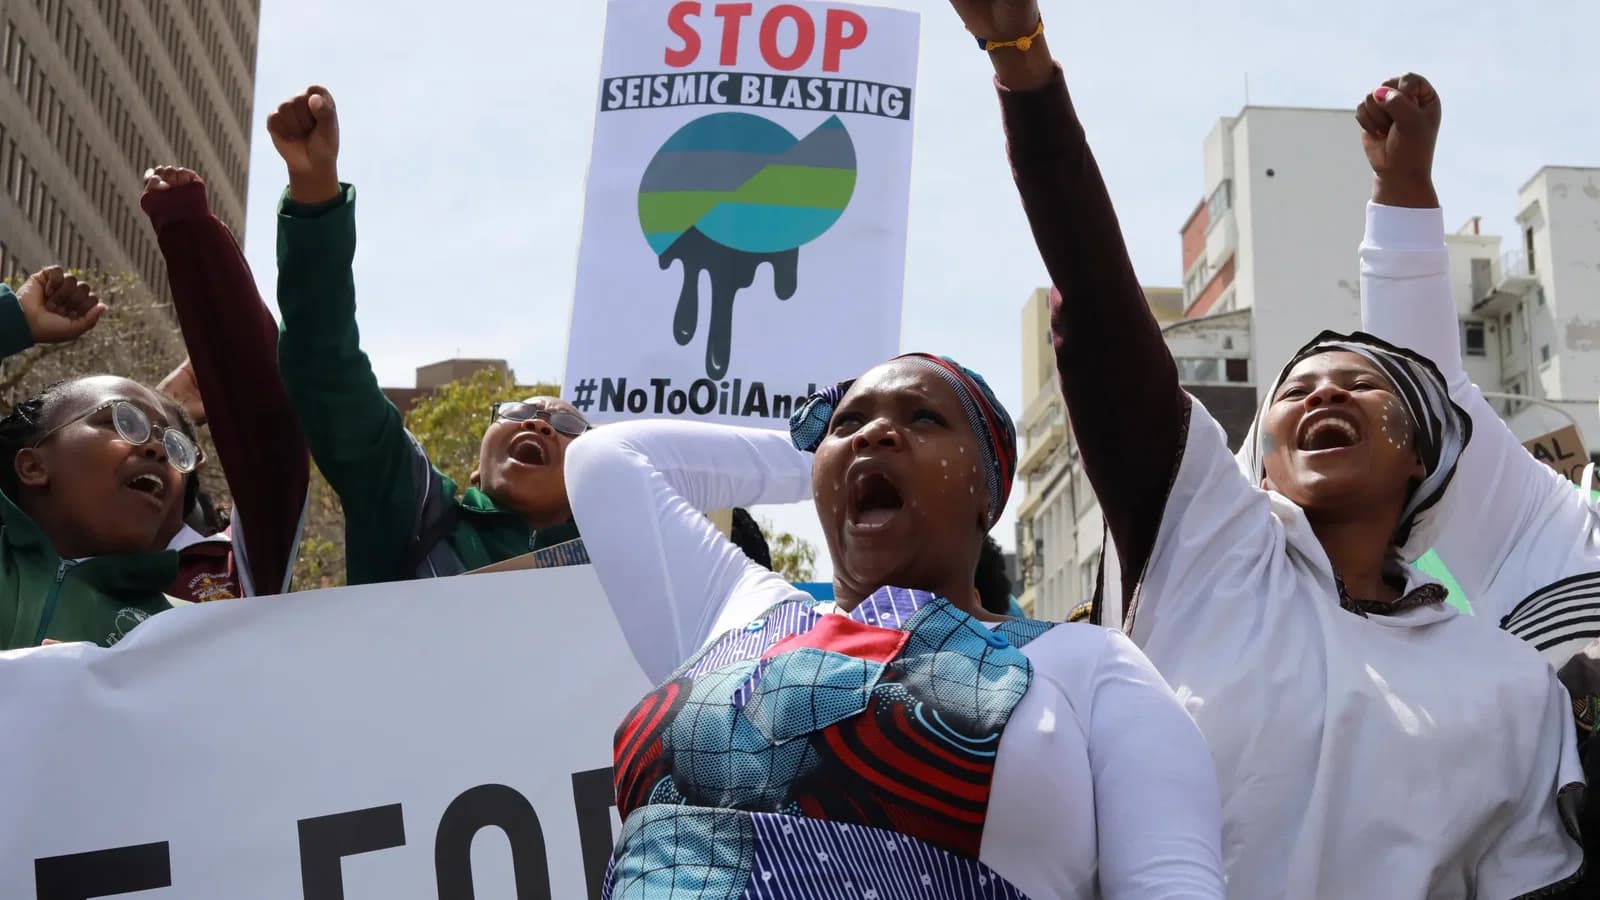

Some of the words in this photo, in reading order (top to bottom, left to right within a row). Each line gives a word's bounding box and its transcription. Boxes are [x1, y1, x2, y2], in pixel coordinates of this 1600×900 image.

[664, 1, 868, 72] STOP
[607, 73, 730, 110] SEISMIC
[739, 75, 905, 117] BLASTING
